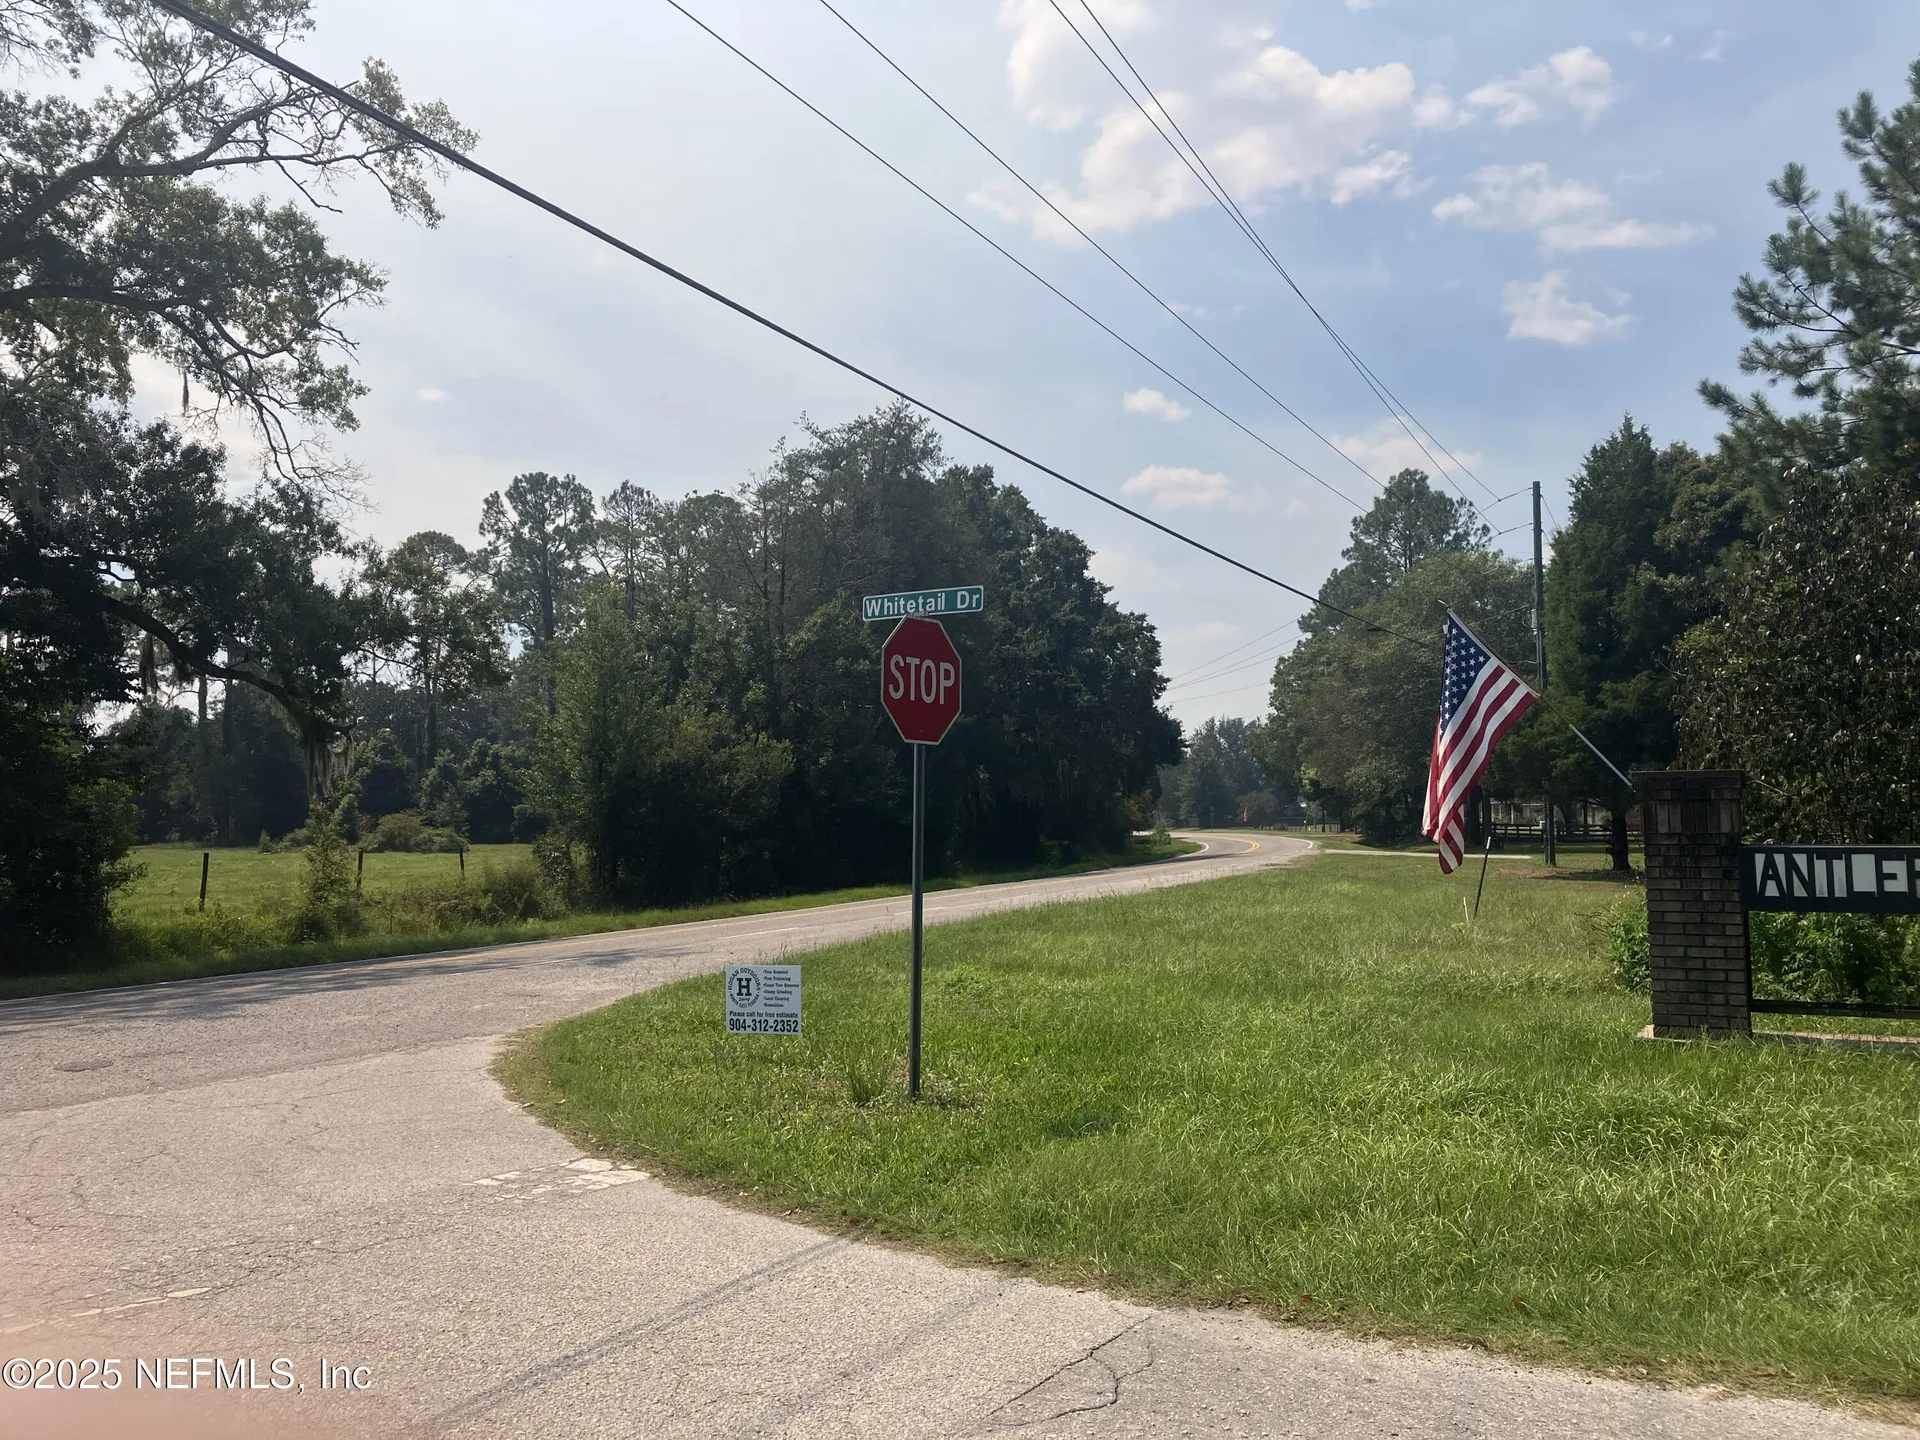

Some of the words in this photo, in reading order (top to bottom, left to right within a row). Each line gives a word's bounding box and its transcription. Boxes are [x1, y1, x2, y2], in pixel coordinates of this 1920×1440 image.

[866, 592, 945, 617] Whitetail
[957, 590, 980, 609] Dr
[888, 653, 955, 704] STOP
[737, 978, 752, 996] H
[729, 1018, 798, 1032] 904-312-2352
